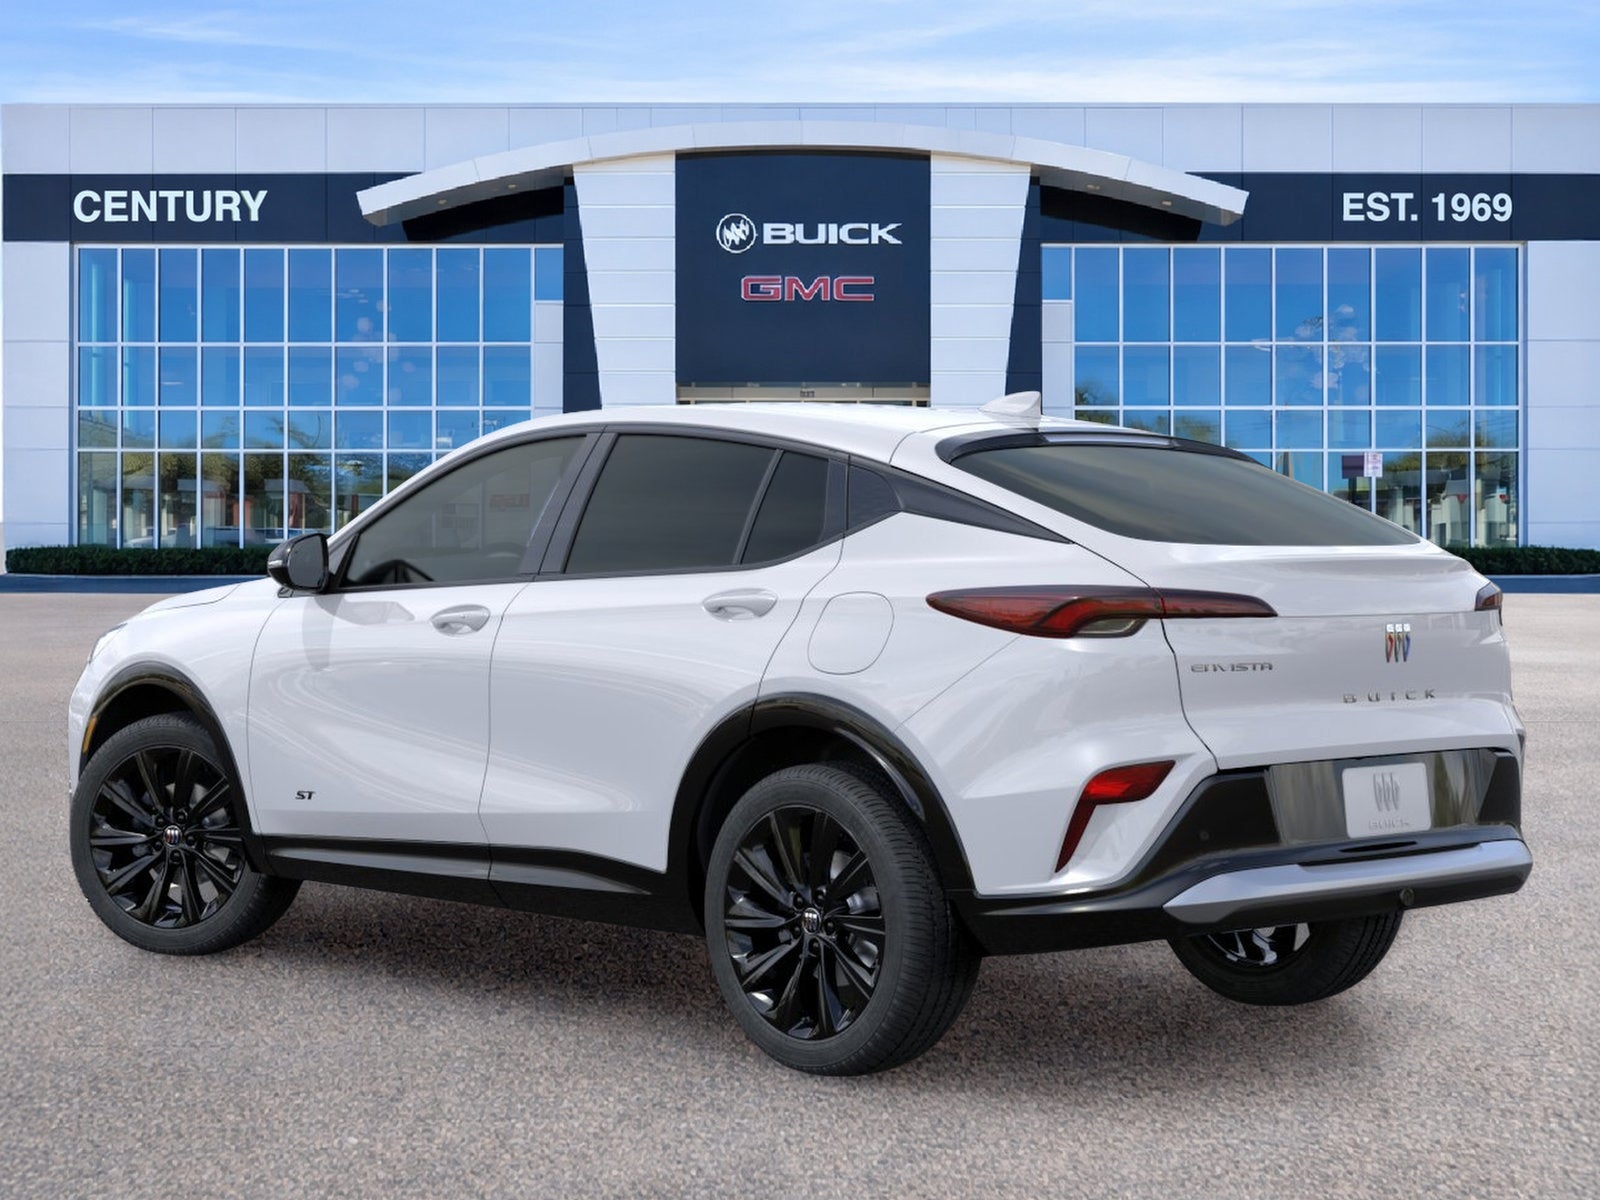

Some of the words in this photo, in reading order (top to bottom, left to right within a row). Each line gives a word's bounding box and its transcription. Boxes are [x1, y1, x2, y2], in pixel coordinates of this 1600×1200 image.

[73, 189, 268, 223] CENTURY
[1342, 191, 1418, 222] EST.
[1431, 192, 1513, 222] 1969
[763, 222, 903, 244] BUICK
[741, 275, 875, 301] GMC
[1190, 662, 1273, 673] ENVISTA
[1343, 689, 1436, 704] BUICK
[295, 790, 316, 800] ST
